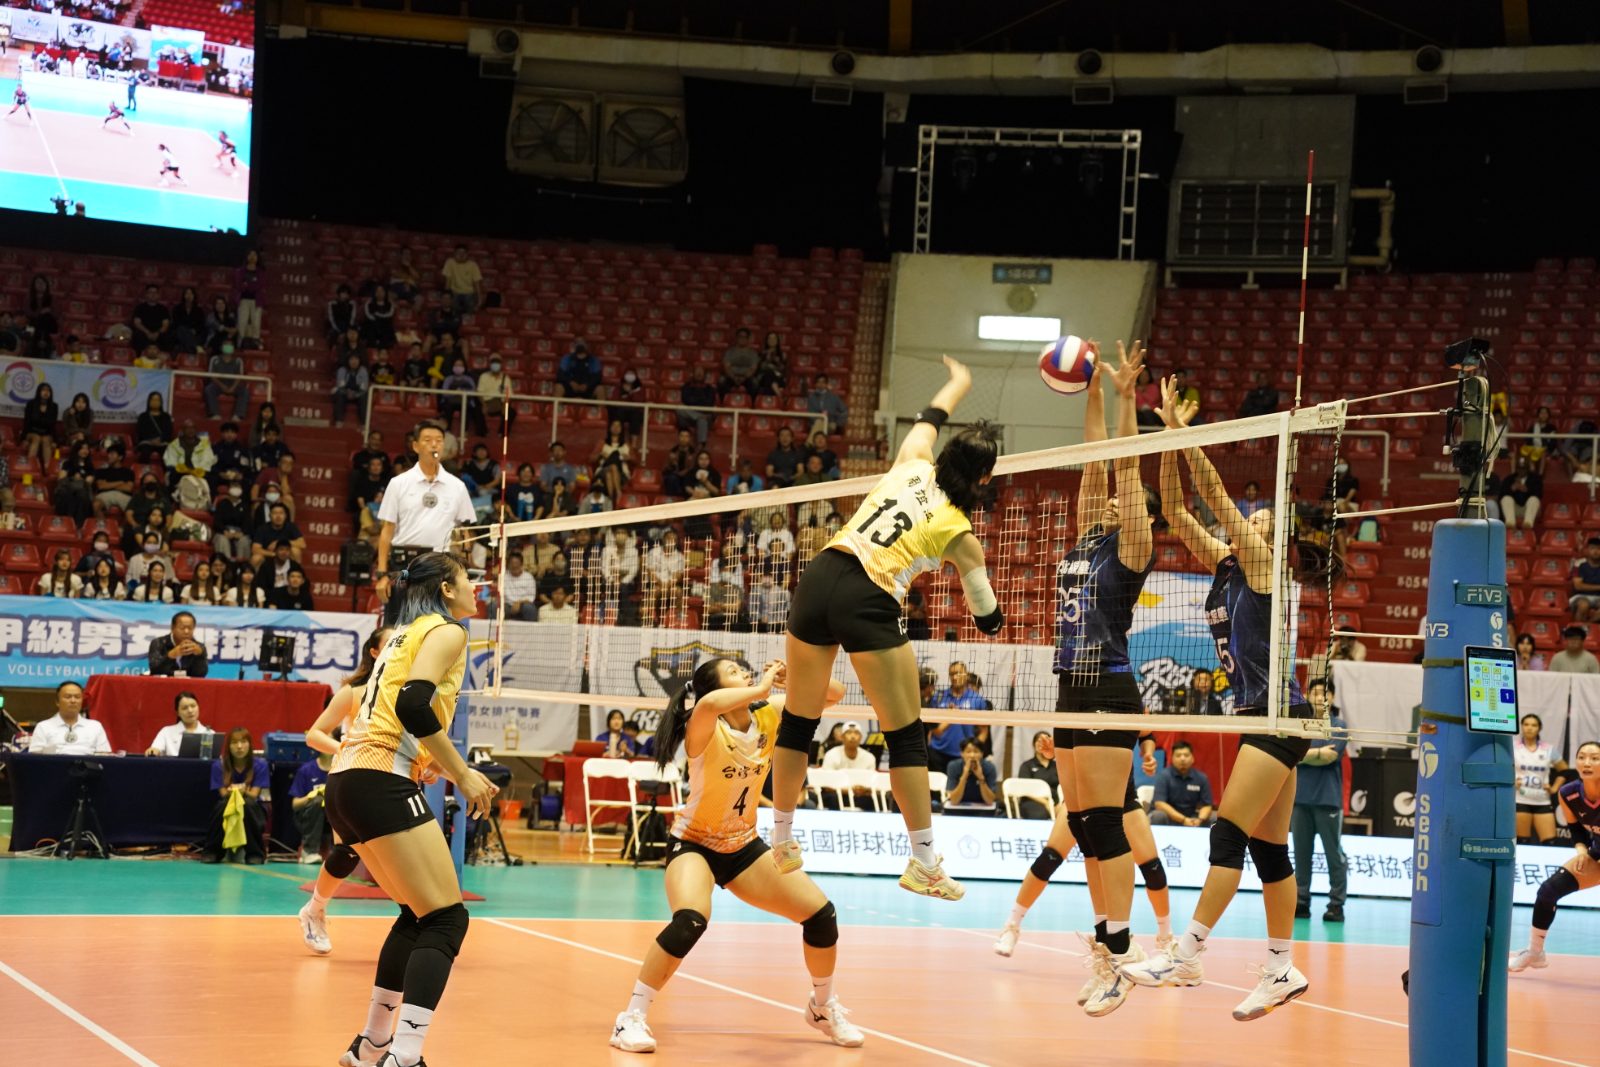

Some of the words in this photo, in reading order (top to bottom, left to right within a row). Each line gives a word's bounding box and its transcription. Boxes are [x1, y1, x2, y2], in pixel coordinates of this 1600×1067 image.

[857, 498, 913, 548] 13
[8, 663, 95, 678] VOLLEYBALL
[407, 794, 426, 817] 11
[733, 786, 749, 816] 4
